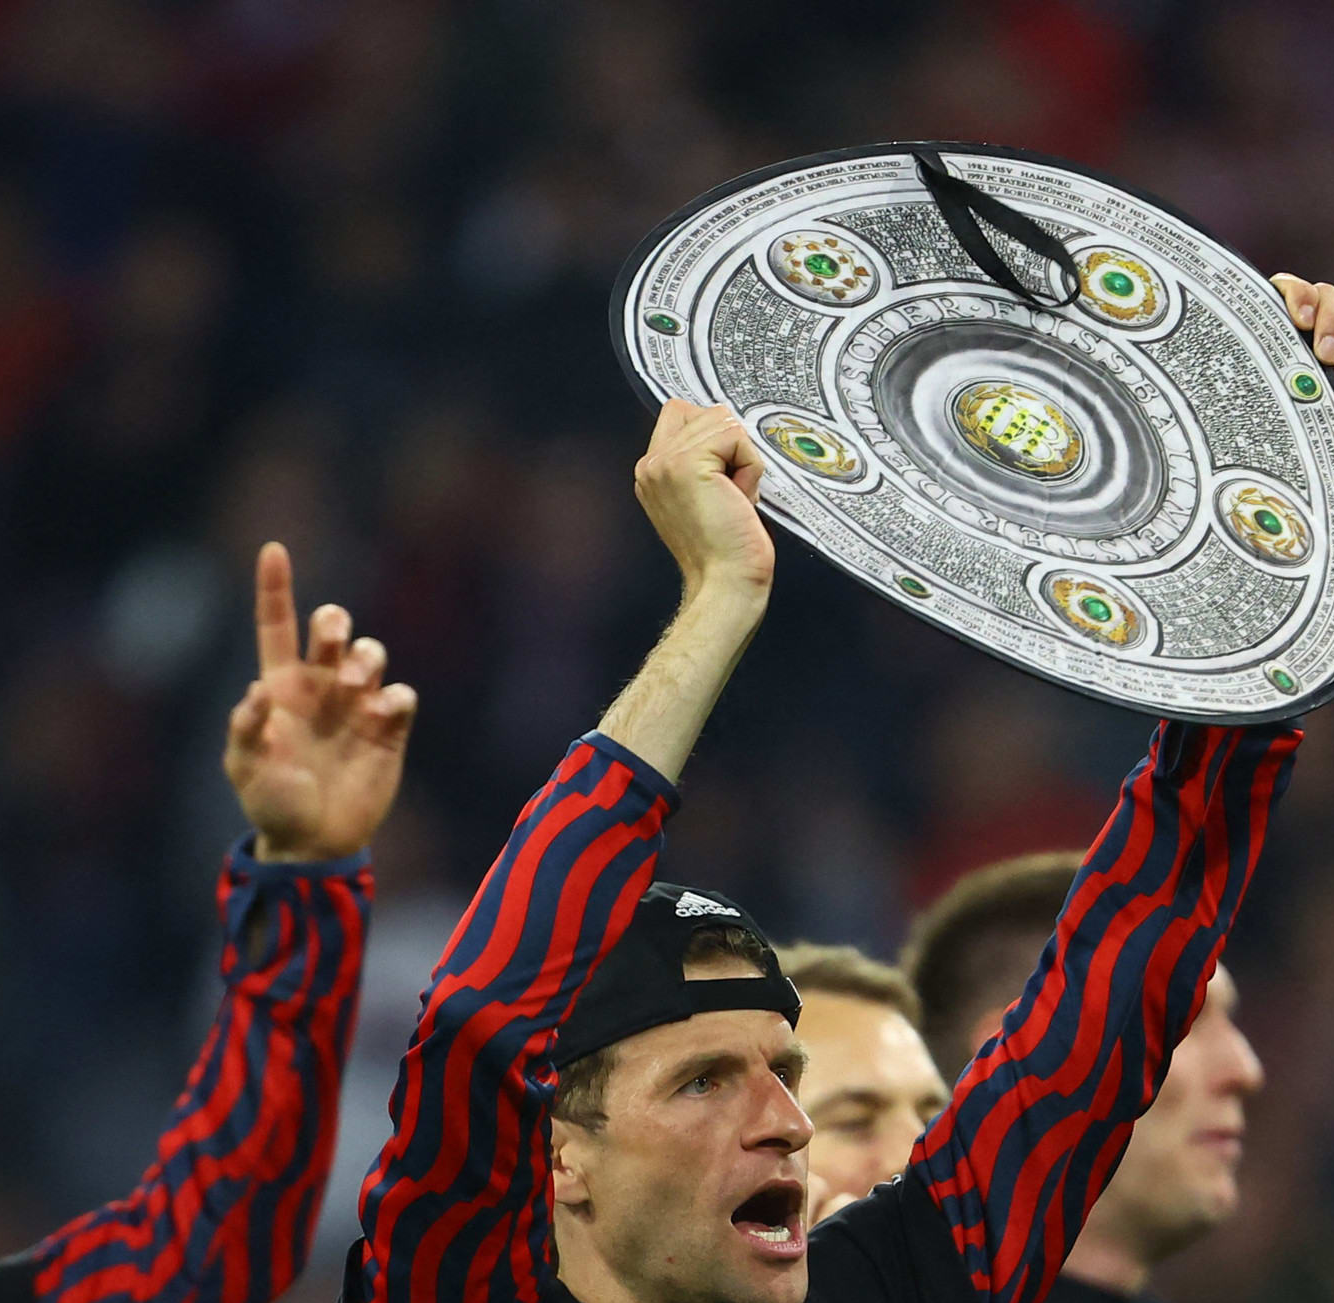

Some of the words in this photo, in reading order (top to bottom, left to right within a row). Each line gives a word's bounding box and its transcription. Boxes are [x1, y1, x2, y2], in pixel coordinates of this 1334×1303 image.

[848, 161, 902, 171] DORTMUND
[848, 171, 898, 183] DORTMUND
[992, 165, 1013, 174] HSV
[1021, 171, 1072, 189] HAMBURG
[1154, 221, 1201, 252] HAMBURG
[1259, 299, 1300, 347] STUTTGART
[999, 177, 1036, 190] BAYERN
[1037, 184, 1084, 204] MÜNCHEN
[1133, 221, 1208, 270] KAISERSLAUTERN
[1237, 293, 1264, 321] BAYERN
[1262, 320, 1294, 359] MÜNCHEN
[1004, 188, 1050, 203] BORUSSIA
[1052, 200, 1106, 223] DORTMUND
[1139, 236, 1170, 256] BAYERN
[1171, 254, 1210, 285] MÜNCHEN
[1235, 307, 1260, 332] BAYERN
[1258, 333, 1284, 369] MÜNCHEN
